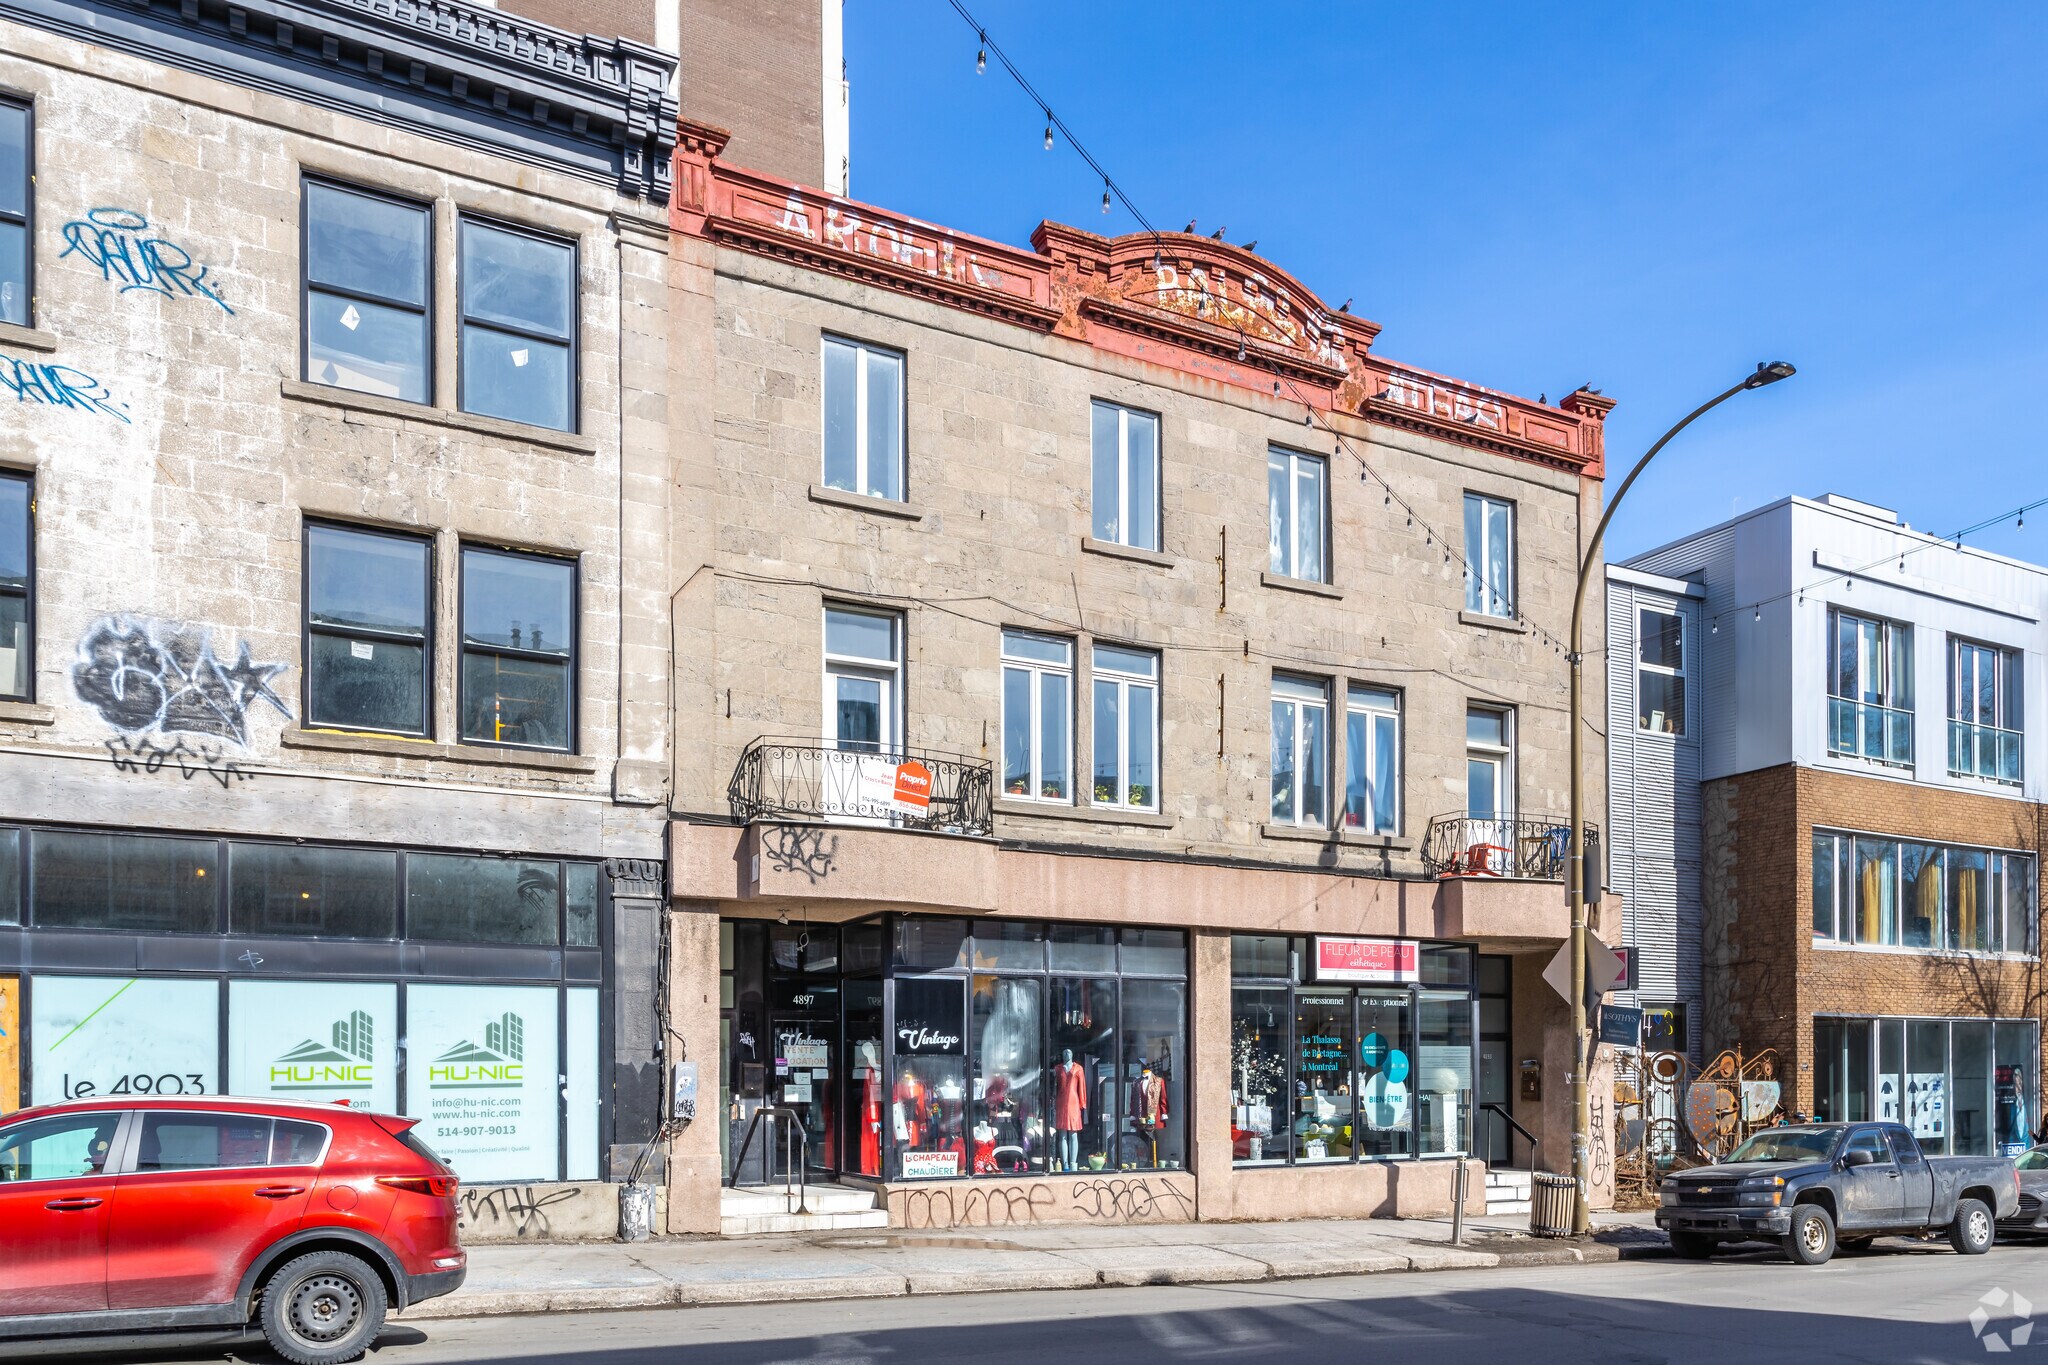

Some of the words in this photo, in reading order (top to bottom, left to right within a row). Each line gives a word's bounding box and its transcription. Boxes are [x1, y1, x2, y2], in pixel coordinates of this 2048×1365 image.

[899, 772, 928, 786] Proprio
[901, 780, 923, 791] Direct
[1325, 943, 1361, 956] FLEUR
[1363, 945, 1378, 957] DE
[1380, 946, 1410, 958] PEAU
[792, 994, 815, 1005] 4897
[1302, 996, 1344, 1006] Professionnel
[1608, 1012, 1638, 1022] SOTHYS
[780, 1032, 828, 1047] Vintage
[899, 1028, 960, 1049] Vintage
[1302, 1035, 1311, 1044] La
[1312, 1035, 1342, 1044] Thalasso
[784, 1046, 815, 1054] VENTE
[1302, 1049, 1311, 1058] de
[1302, 1062, 1307, 1071] à
[1308, 1062, 1338, 1071] Montréal
[271, 1065, 373, 1081] HU-NIC
[430, 1065, 523, 1081] HU-NIC
[64, 1073, 96, 1100] le
[109, 1073, 205, 1096] 4903
[432, 1097, 521, 1108] info@hu-nic.com
[1368, 1094, 1403, 1103] BIEN-ÊTRE
[432, 1109, 521, 1119] www.hu-nic.com
[437, 1125, 516, 1137] 514-907-9013
[913, 1153, 957, 1162] CHAPEAUX
